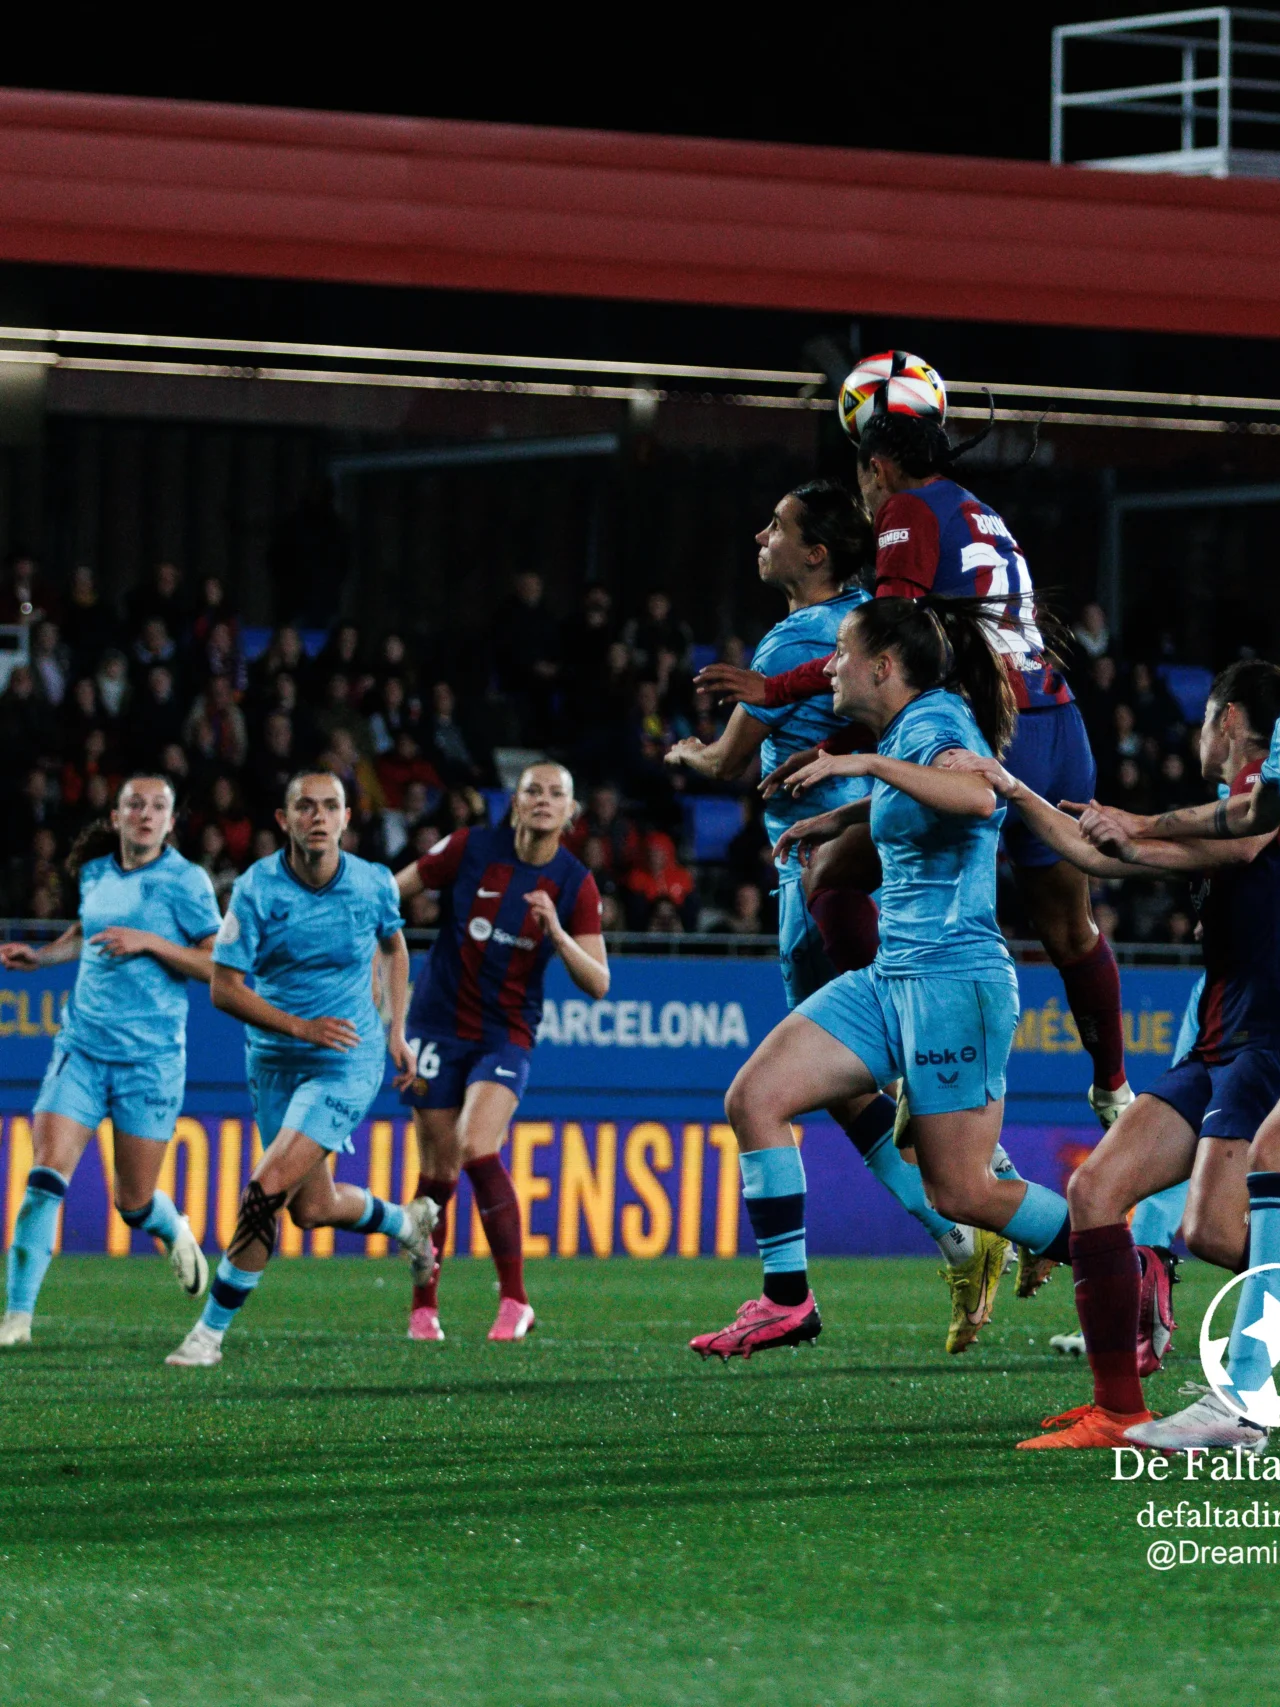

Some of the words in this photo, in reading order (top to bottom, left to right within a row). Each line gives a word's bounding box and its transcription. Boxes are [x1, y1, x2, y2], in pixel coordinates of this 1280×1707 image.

[878, 529, 910, 549] BIMBO
[0, 990, 71, 1038] CLU
[536, 998, 749, 1048] ARCELONA
[1123, 1010, 1174, 1055] UE
[915, 1049, 958, 1066] bbk
